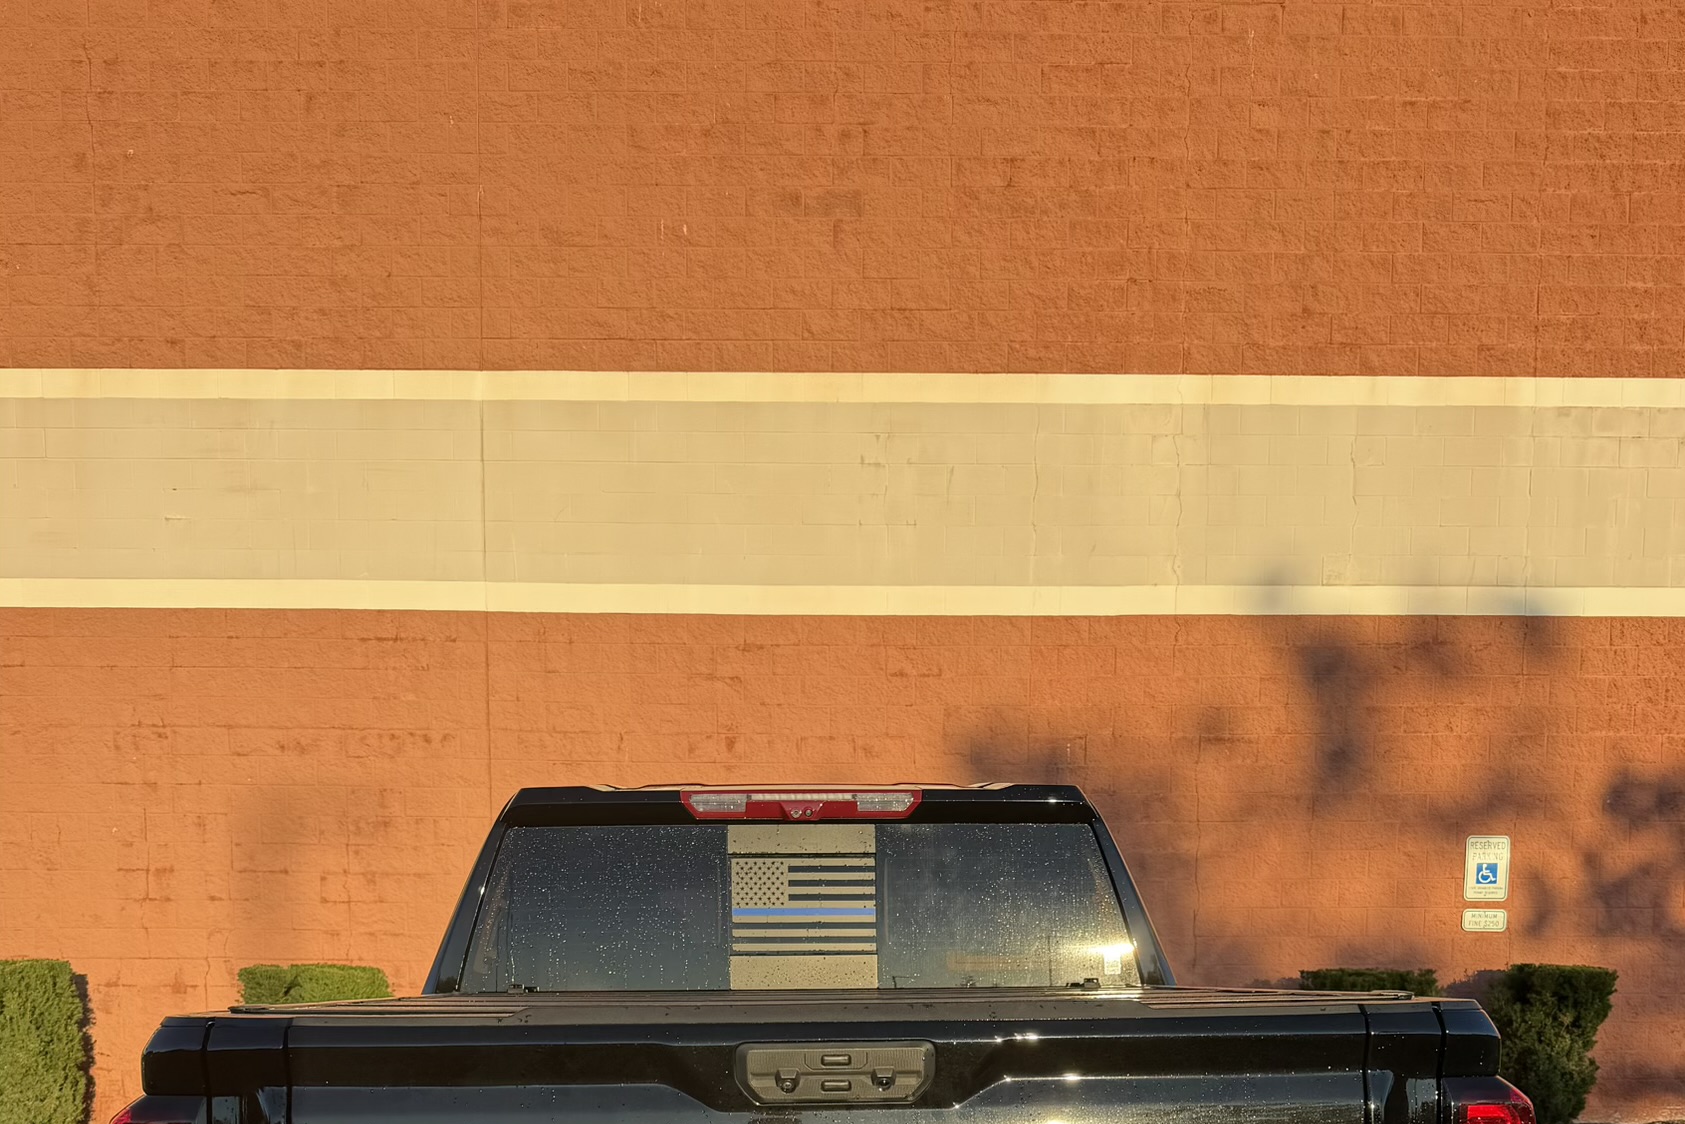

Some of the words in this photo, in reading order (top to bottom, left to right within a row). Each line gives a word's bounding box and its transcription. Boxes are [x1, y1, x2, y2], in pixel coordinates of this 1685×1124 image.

[1470, 841, 1506, 850] RESERVED
[1472, 852, 1504, 861] PARKING
[1484, 920, 1500, 928] $250
